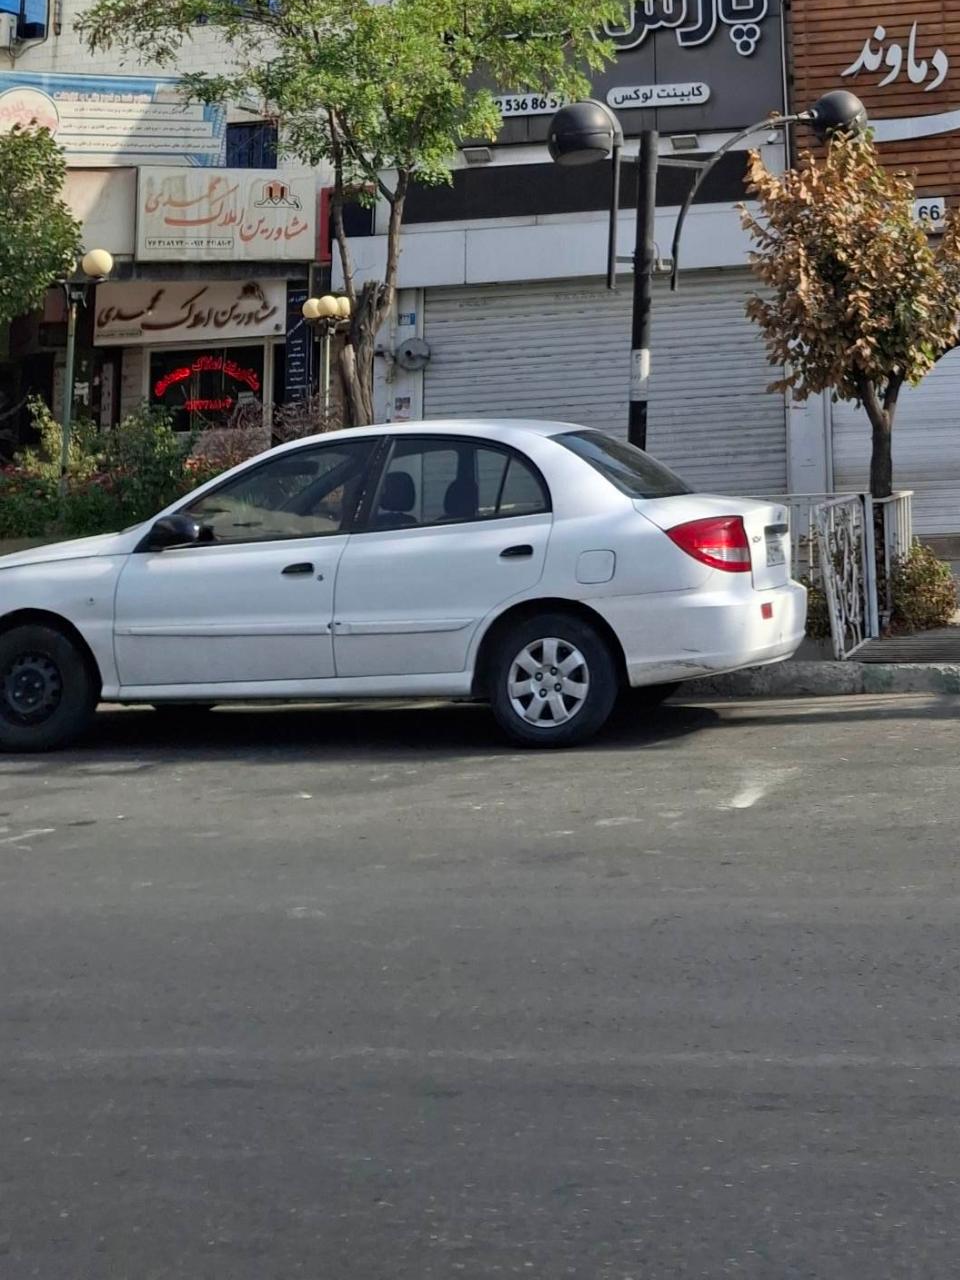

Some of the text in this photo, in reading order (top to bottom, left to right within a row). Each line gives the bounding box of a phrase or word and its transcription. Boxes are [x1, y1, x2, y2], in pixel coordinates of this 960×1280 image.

[840, 20, 949, 92] دماوند
[613, 86, 704, 105] کابینت لوکس
